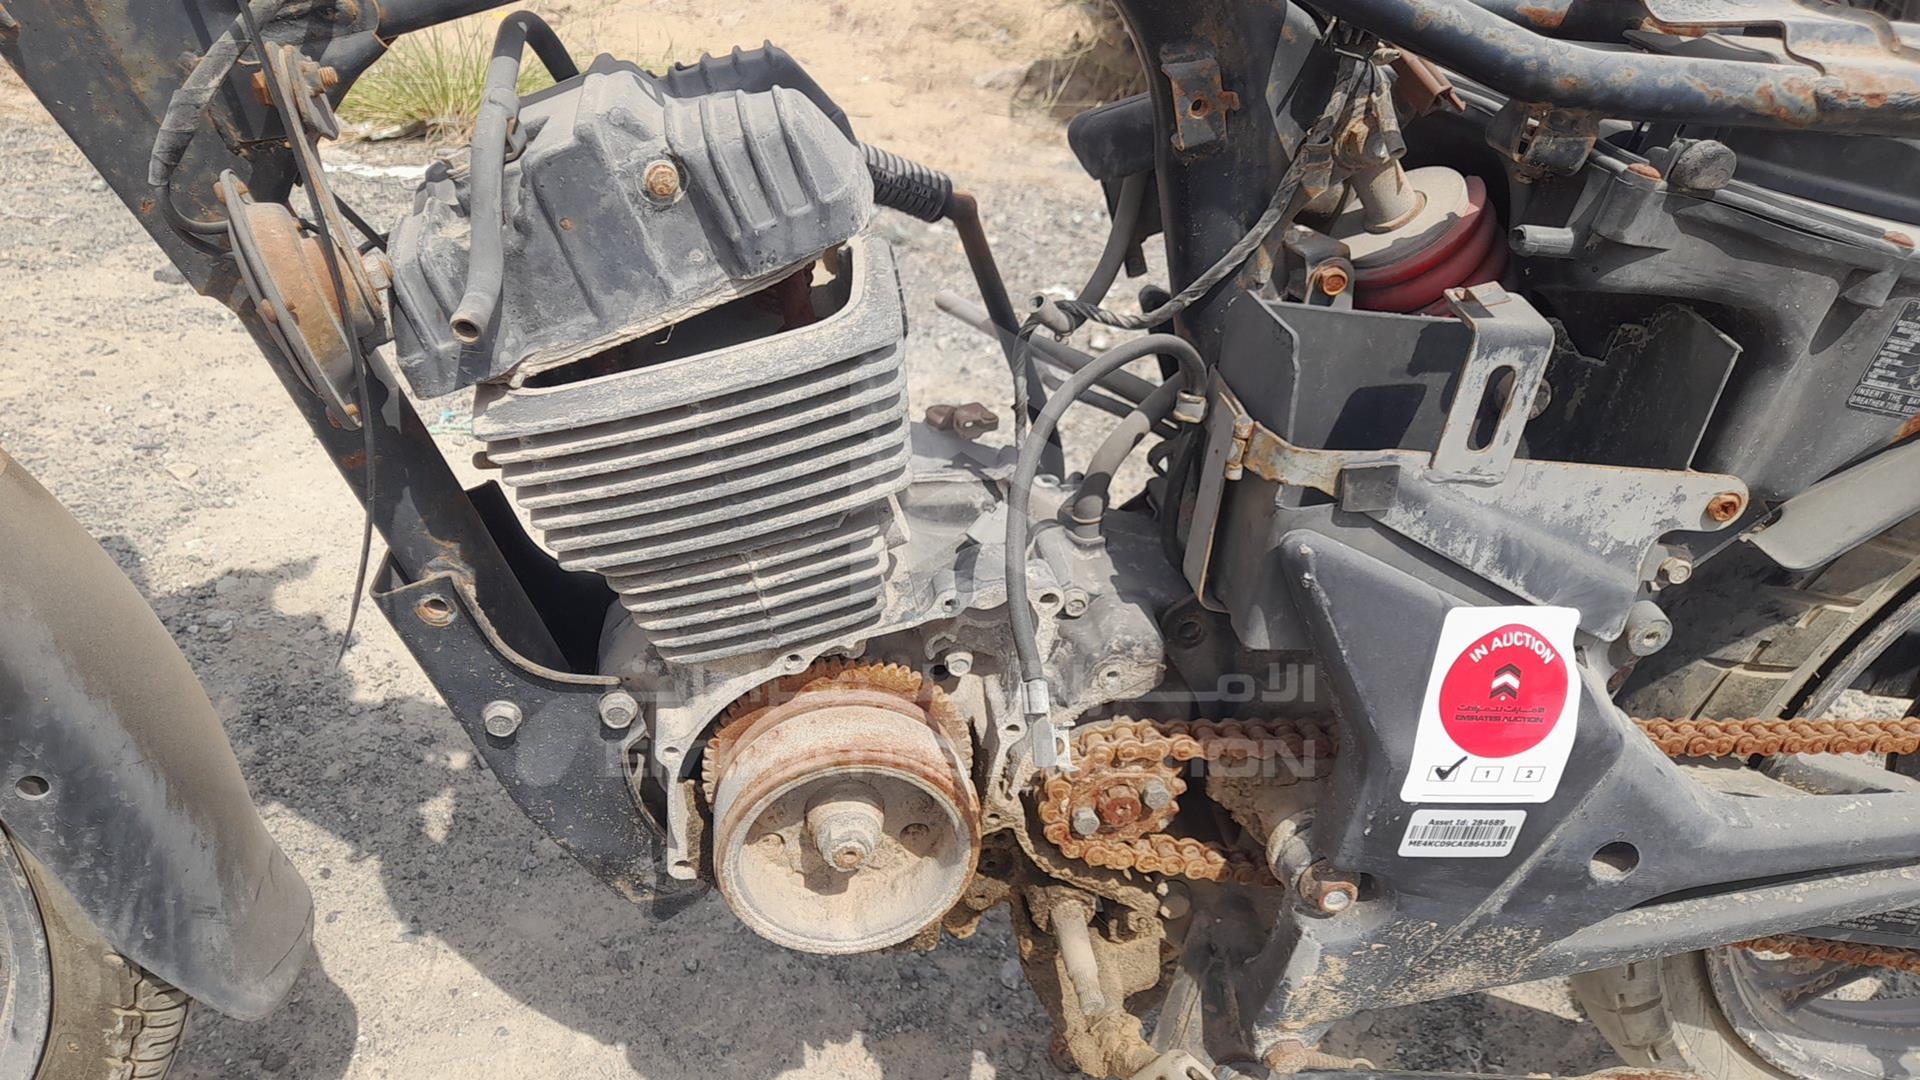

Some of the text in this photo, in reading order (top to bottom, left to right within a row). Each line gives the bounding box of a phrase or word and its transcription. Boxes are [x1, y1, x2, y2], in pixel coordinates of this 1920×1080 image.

[1856, 387, 1885, 399] INSERT
[1887, 393, 1903, 403] THE
[1469, 631, 1556, 665] IN AUCTION
[1502, 715, 1544, 723] AUCTION
[1484, 770, 1490, 779] 1
[1525, 770, 1533, 779] 2
[1428, 818, 1454, 826] Asset
